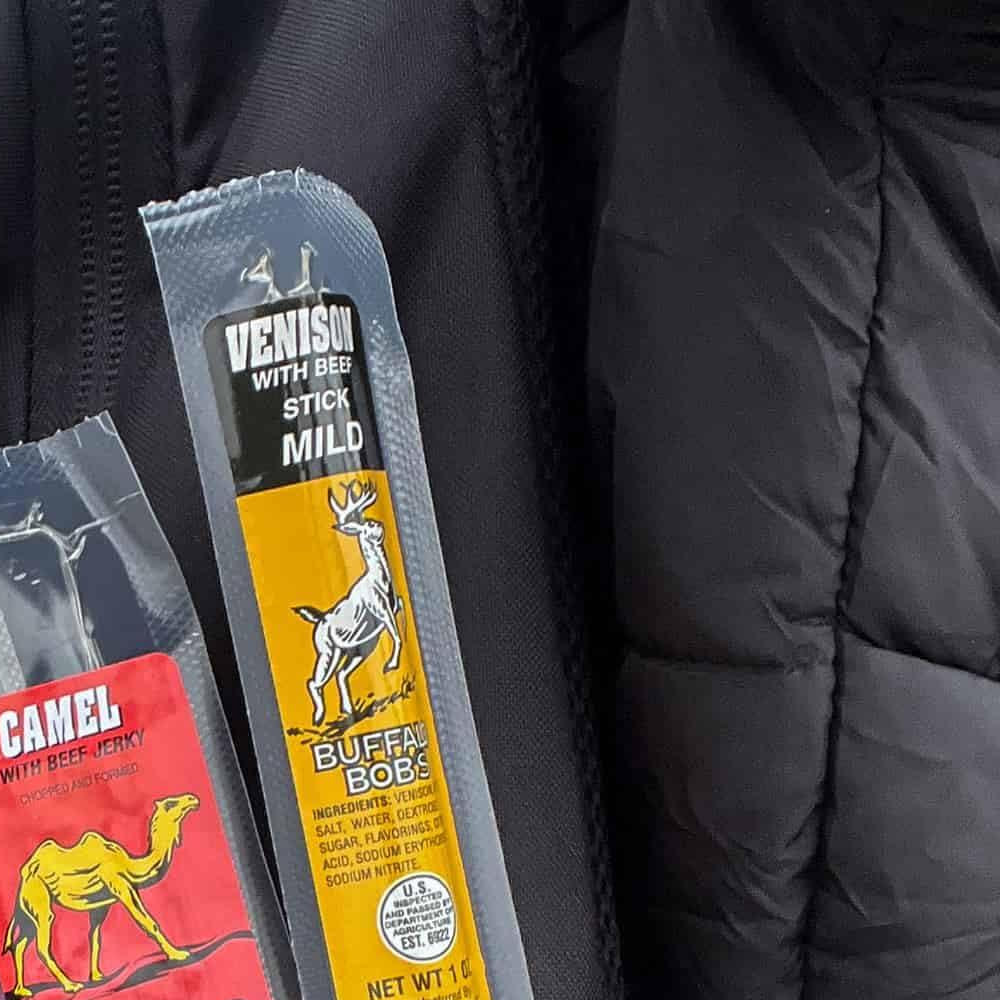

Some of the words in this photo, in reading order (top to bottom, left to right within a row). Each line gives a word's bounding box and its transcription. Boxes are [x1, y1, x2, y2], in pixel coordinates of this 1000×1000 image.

[225, 304, 355, 373] VENISON
[252, 359, 308, 392] WITH
[315, 355, 352, 376] BEEF
[283, 387, 350, 420] STICK
[282, 420, 364, 466] MILD
[0, 757, 42, 785] WITH
[47, 746, 88, 772] BEEF
[93, 728, 146, 758] JERKY
[19, 781, 69, 806] CHOPPED
[71, 774, 92, 793] AND
[94, 762, 138, 785] FORMED
[312, 794, 393, 821] INGREDIENTS:
[315, 823, 347, 838] SALT,
[351, 811, 395, 830] WATER,
[319, 836, 363, 854] SUGAR,
[323, 854, 353, 872] ACID,
[355, 844, 401, 865] SODIUM
[325, 867, 374, 888] SODIUM
[402, 880, 432, 898] U.S.
[401, 932, 426, 950] EST.
[367, 975, 405, 1000] NET
[412, 968, 442, 994] WT
[450, 965, 458, 983] 1
